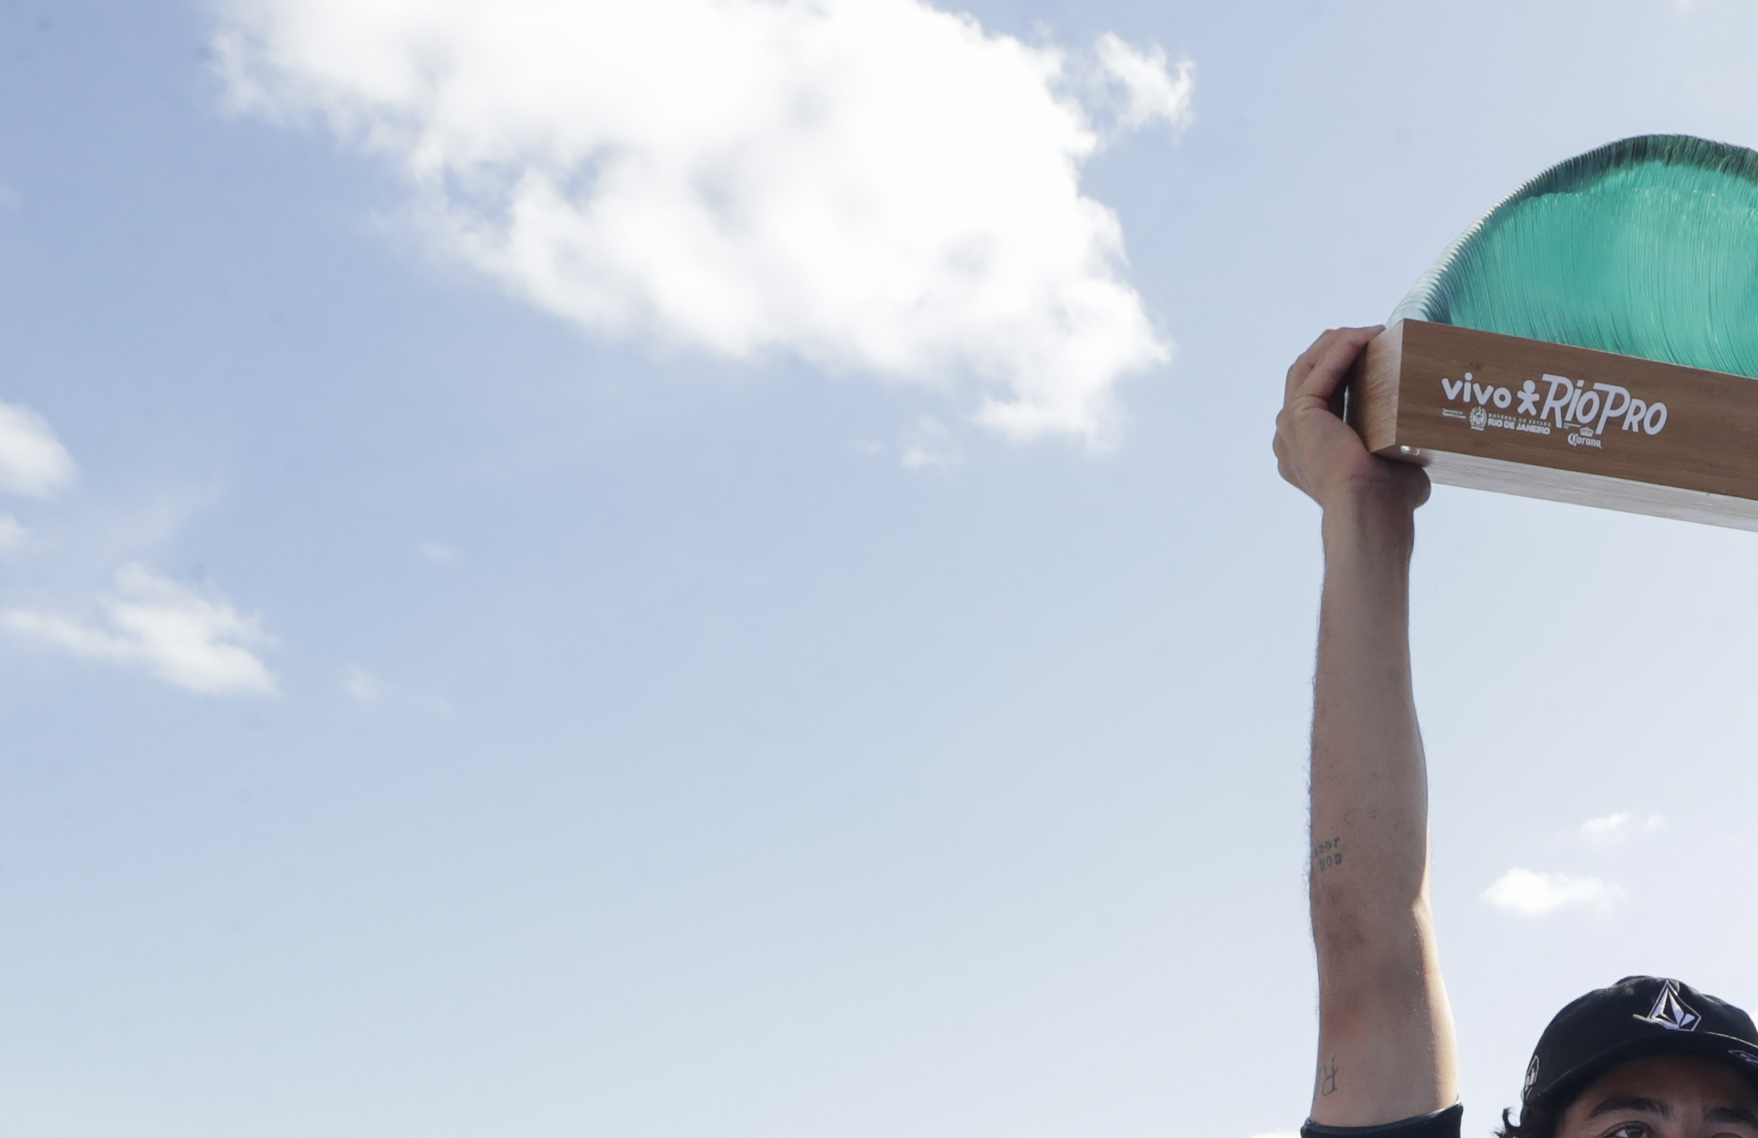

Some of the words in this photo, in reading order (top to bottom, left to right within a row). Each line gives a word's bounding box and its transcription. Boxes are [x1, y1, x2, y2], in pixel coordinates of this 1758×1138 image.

[1441, 372, 1512, 409] vivo
[1488, 418, 1503, 427] RIO
[1504, 421, 1515, 430] DE
[1516, 423, 1550, 435] JANEIRO
